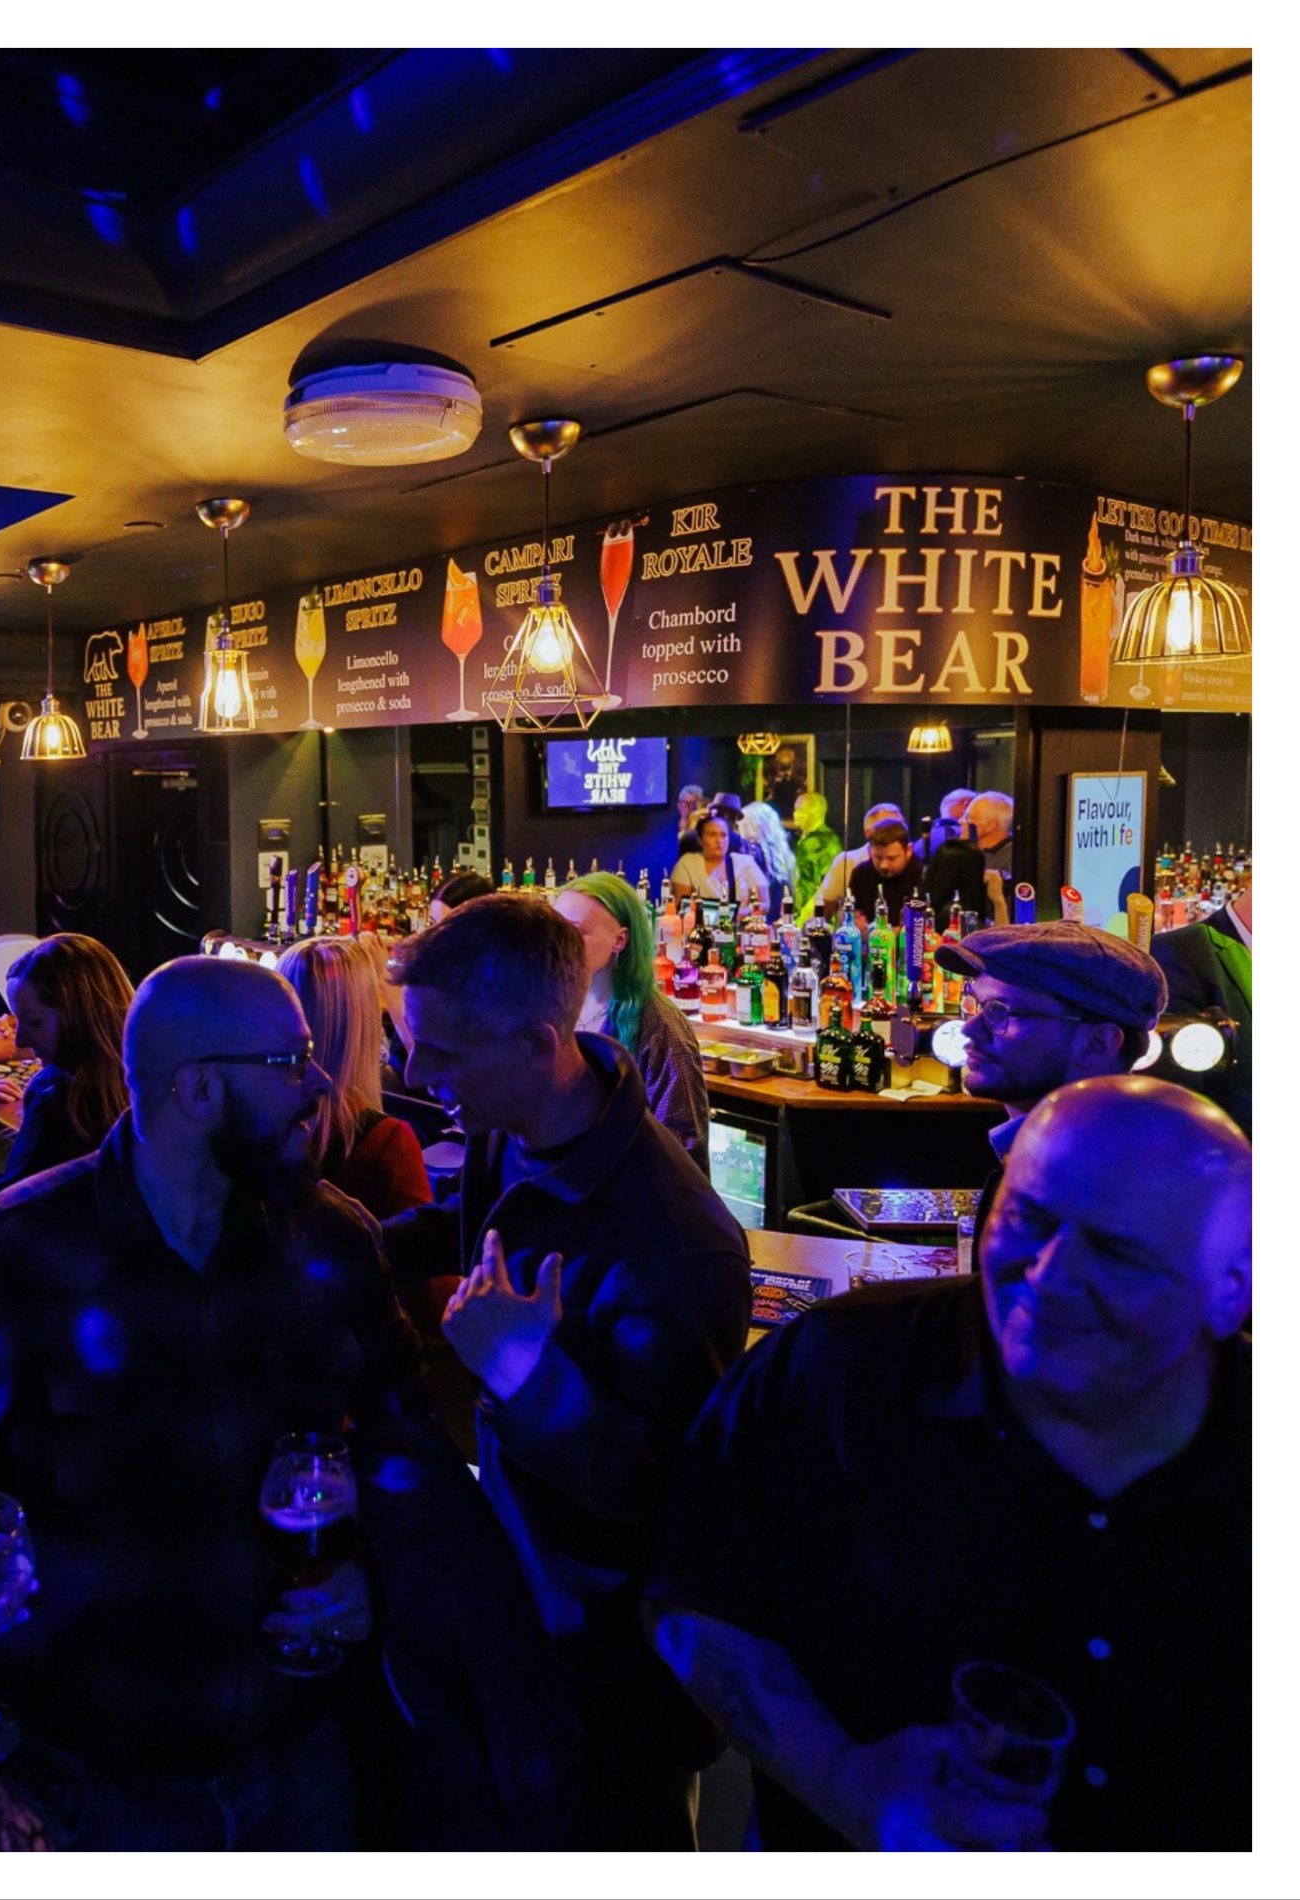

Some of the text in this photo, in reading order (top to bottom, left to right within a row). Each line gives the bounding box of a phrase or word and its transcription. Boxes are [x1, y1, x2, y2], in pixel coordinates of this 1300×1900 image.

[670, 503, 720, 537] KIR
[874, 486, 1003, 537] THE
[1097, 496, 1127, 527] LET
[1128, 503, 1157, 533] THE
[1202, 518, 1239, 549] TIMES
[484, 535, 575, 576] CAMPARI
[641, 538, 753, 580] ROYALE
[324, 568, 423, 607] LIMONCELLO
[496, 572, 562, 608] SPRIZ
[774, 547, 1063, 618] WHITE
[230, 600, 265, 625] HUGO
[345, 603, 397, 632] SPRITZ
[648, 602, 736, 630] Chambord
[147, 617, 186, 640] APEROL
[232, 626, 268, 650] PRITZ
[150, 641, 183, 663] SPRITZ
[642, 633, 741, 662] topped with
[346, 650, 399, 670] Limoncello
[484, 660, 537, 681] length
[813, 630, 1033, 695] BEAR
[95, 683, 112, 697] THE
[156, 679, 177, 694] Aperol
[338, 671, 410, 695] lengthened with
[652, 668, 729, 691] prosecco
[85, 698, 125, 719] WHITE
[336, 694, 411, 717] prosecco & soda
[91, 720, 121, 740] BEAR
[1078, 798, 1132, 822] Flavour,
[1077, 827, 1108, 849] with
[913, 917, 924, 968] STRONGBOW
